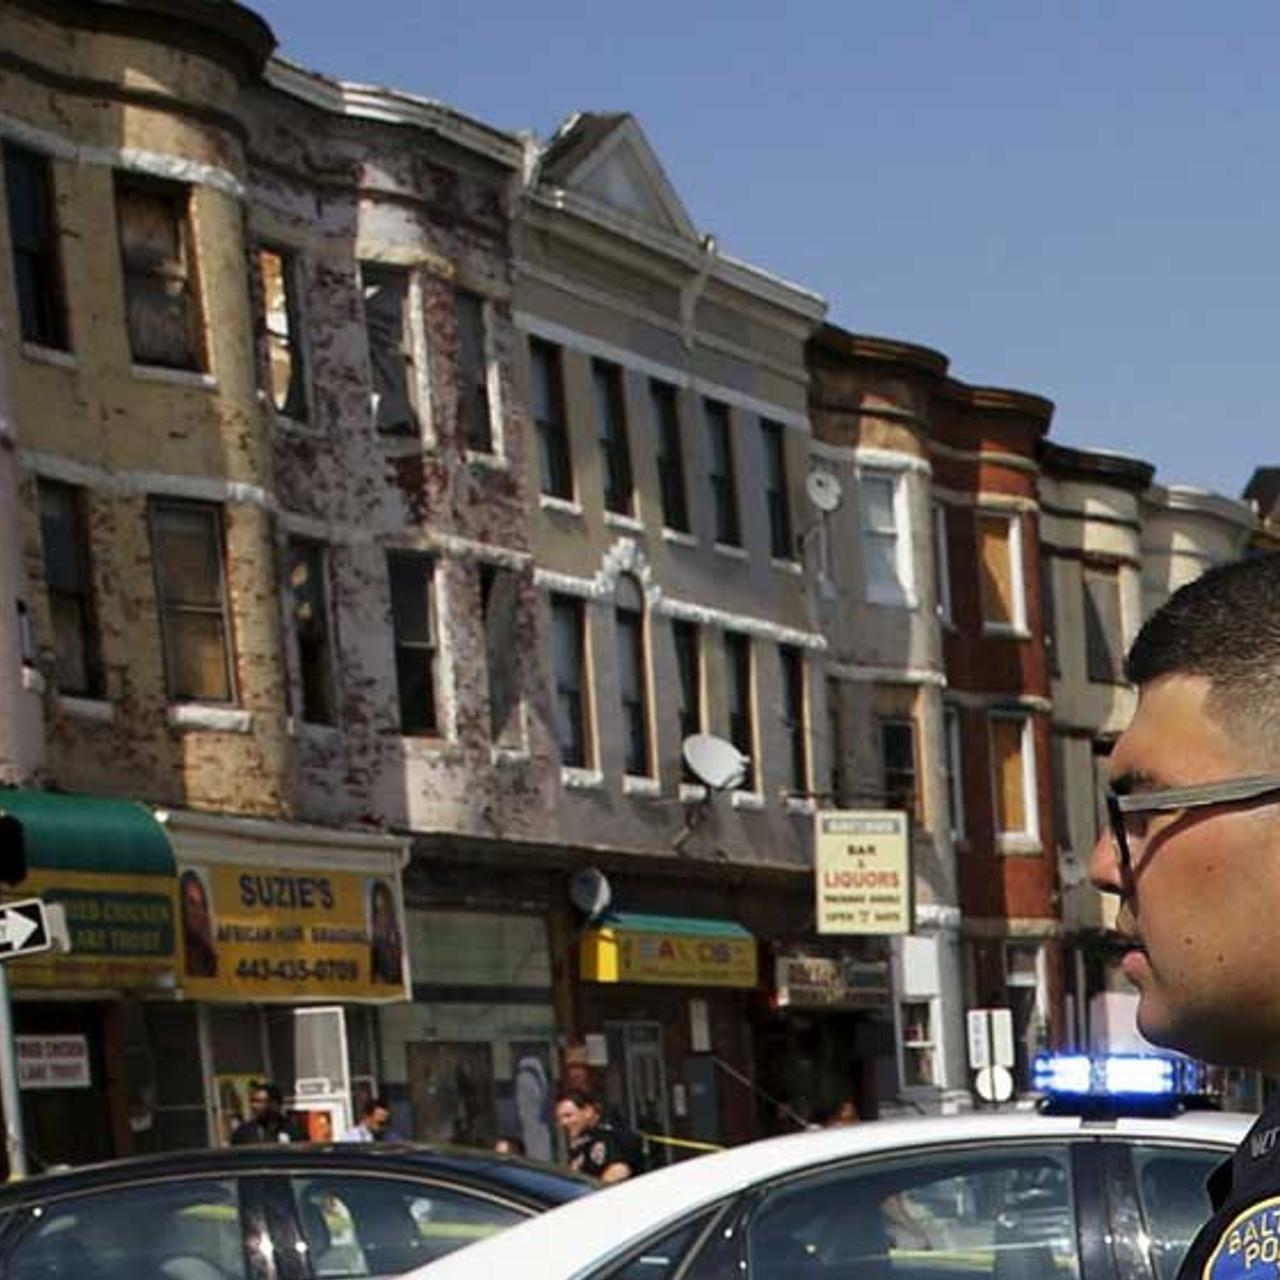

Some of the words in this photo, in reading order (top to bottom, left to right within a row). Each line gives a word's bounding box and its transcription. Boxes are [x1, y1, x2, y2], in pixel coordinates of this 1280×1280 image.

[847, 845, 876, 856] BAR
[824, 871, 900, 889] LIQUORS
[239, 874, 335, 910] SUZIE'S
